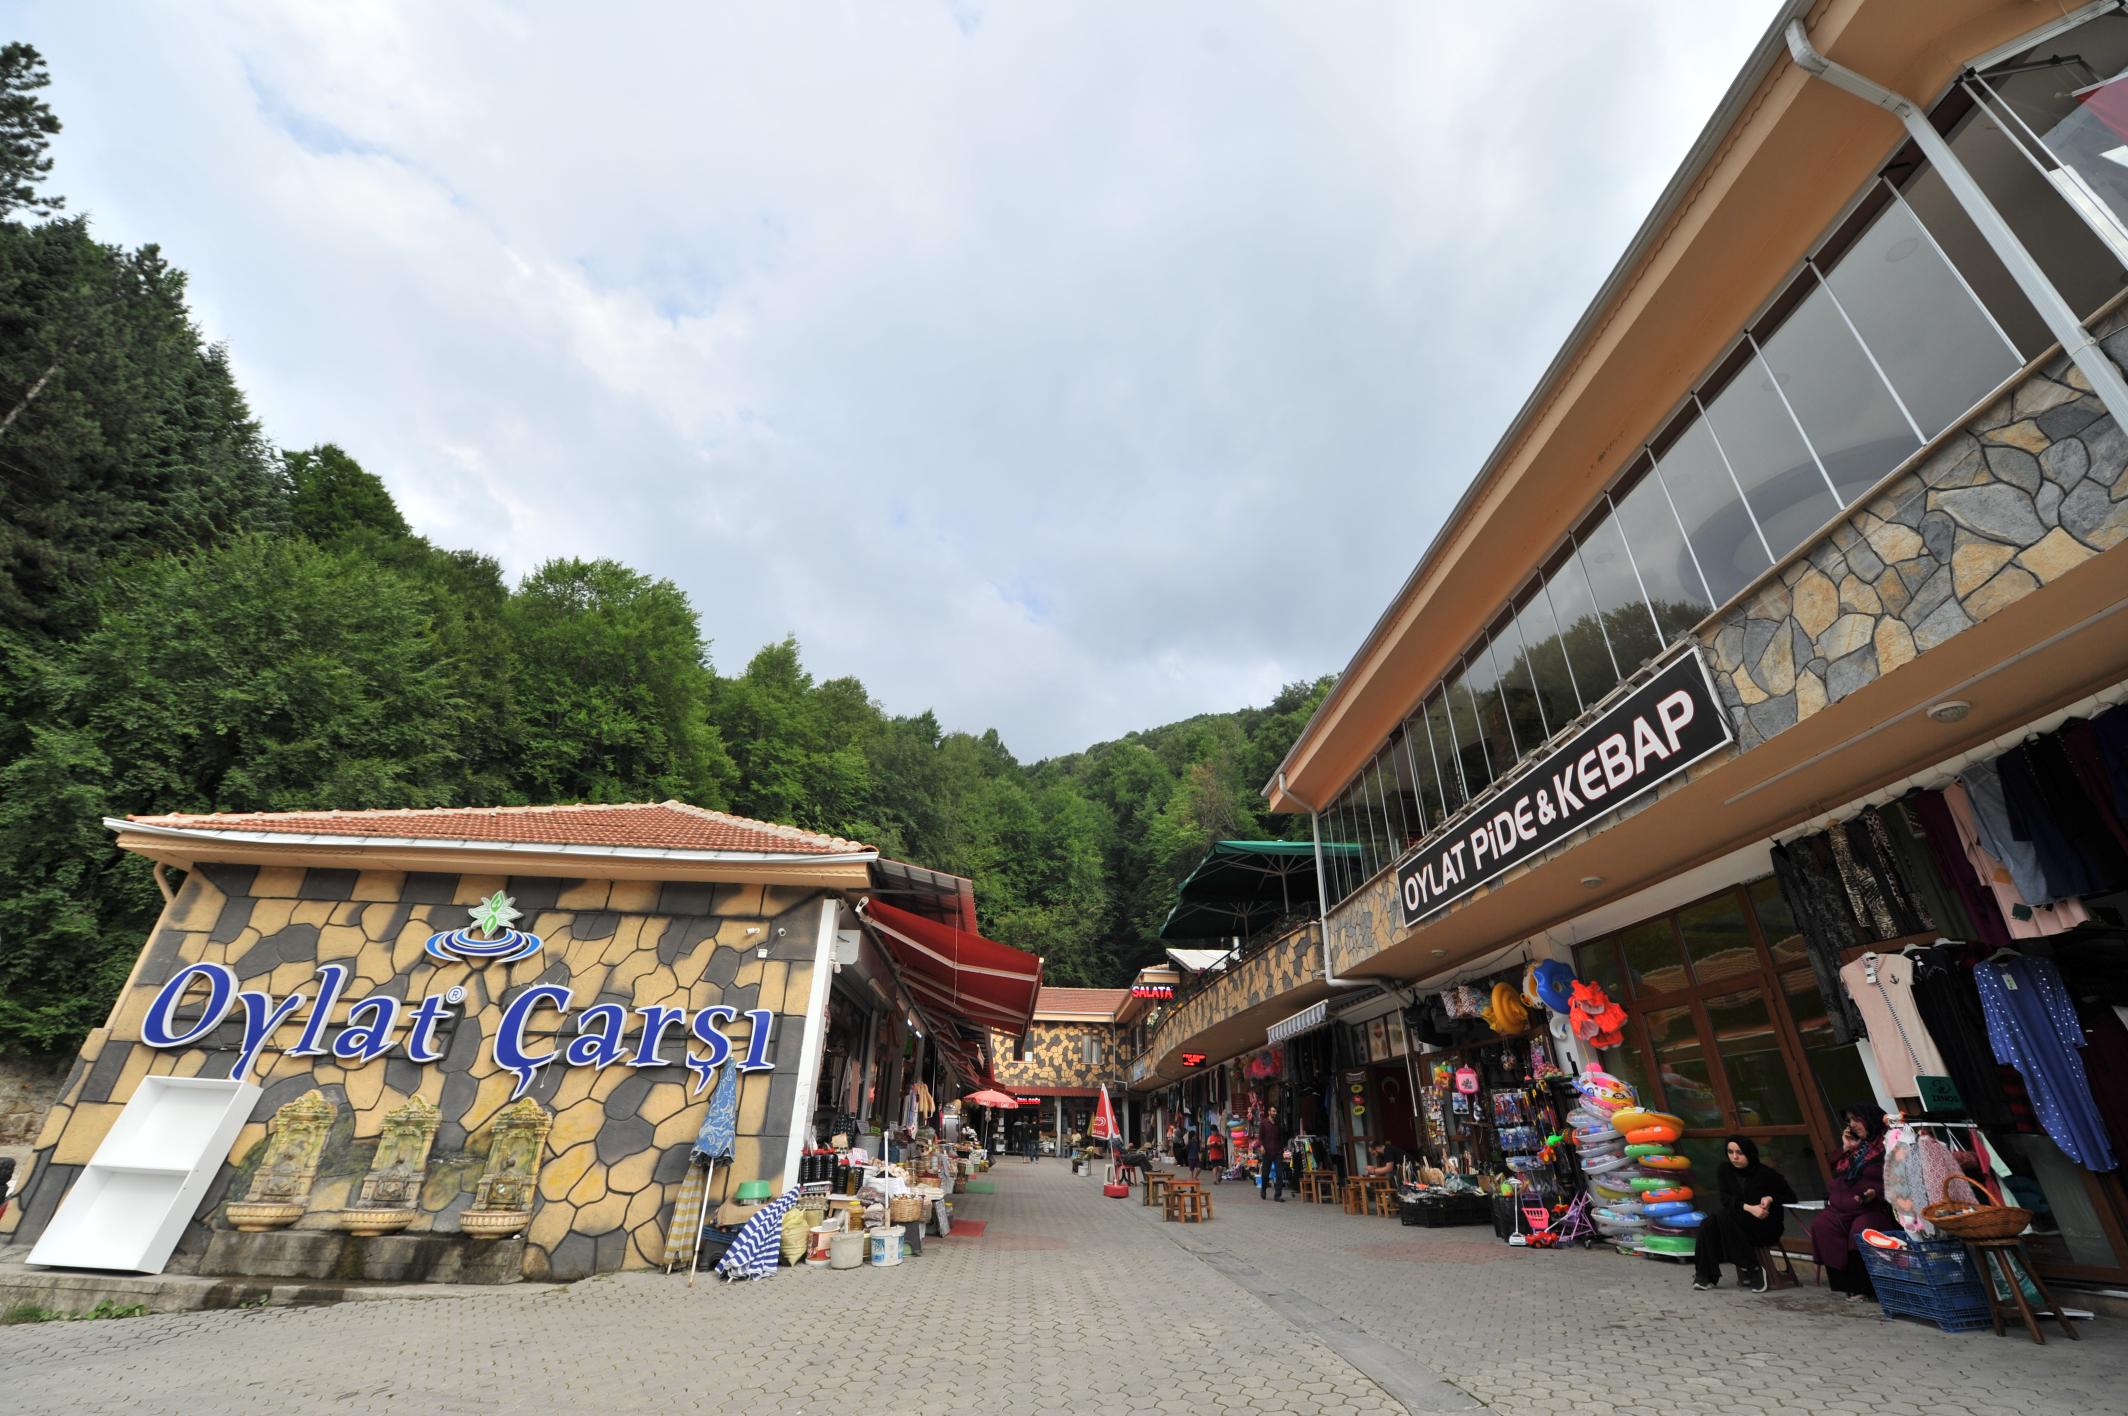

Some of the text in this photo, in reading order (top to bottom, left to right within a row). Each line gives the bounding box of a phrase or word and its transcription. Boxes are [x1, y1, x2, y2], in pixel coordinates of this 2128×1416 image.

[1404, 841, 1466, 911] OYLAT
[1553, 690, 1695, 818] KEBAP
[141, 962, 775, 1100] Oylat Çarşı
[1131, 985, 1173, 998] SALATA
